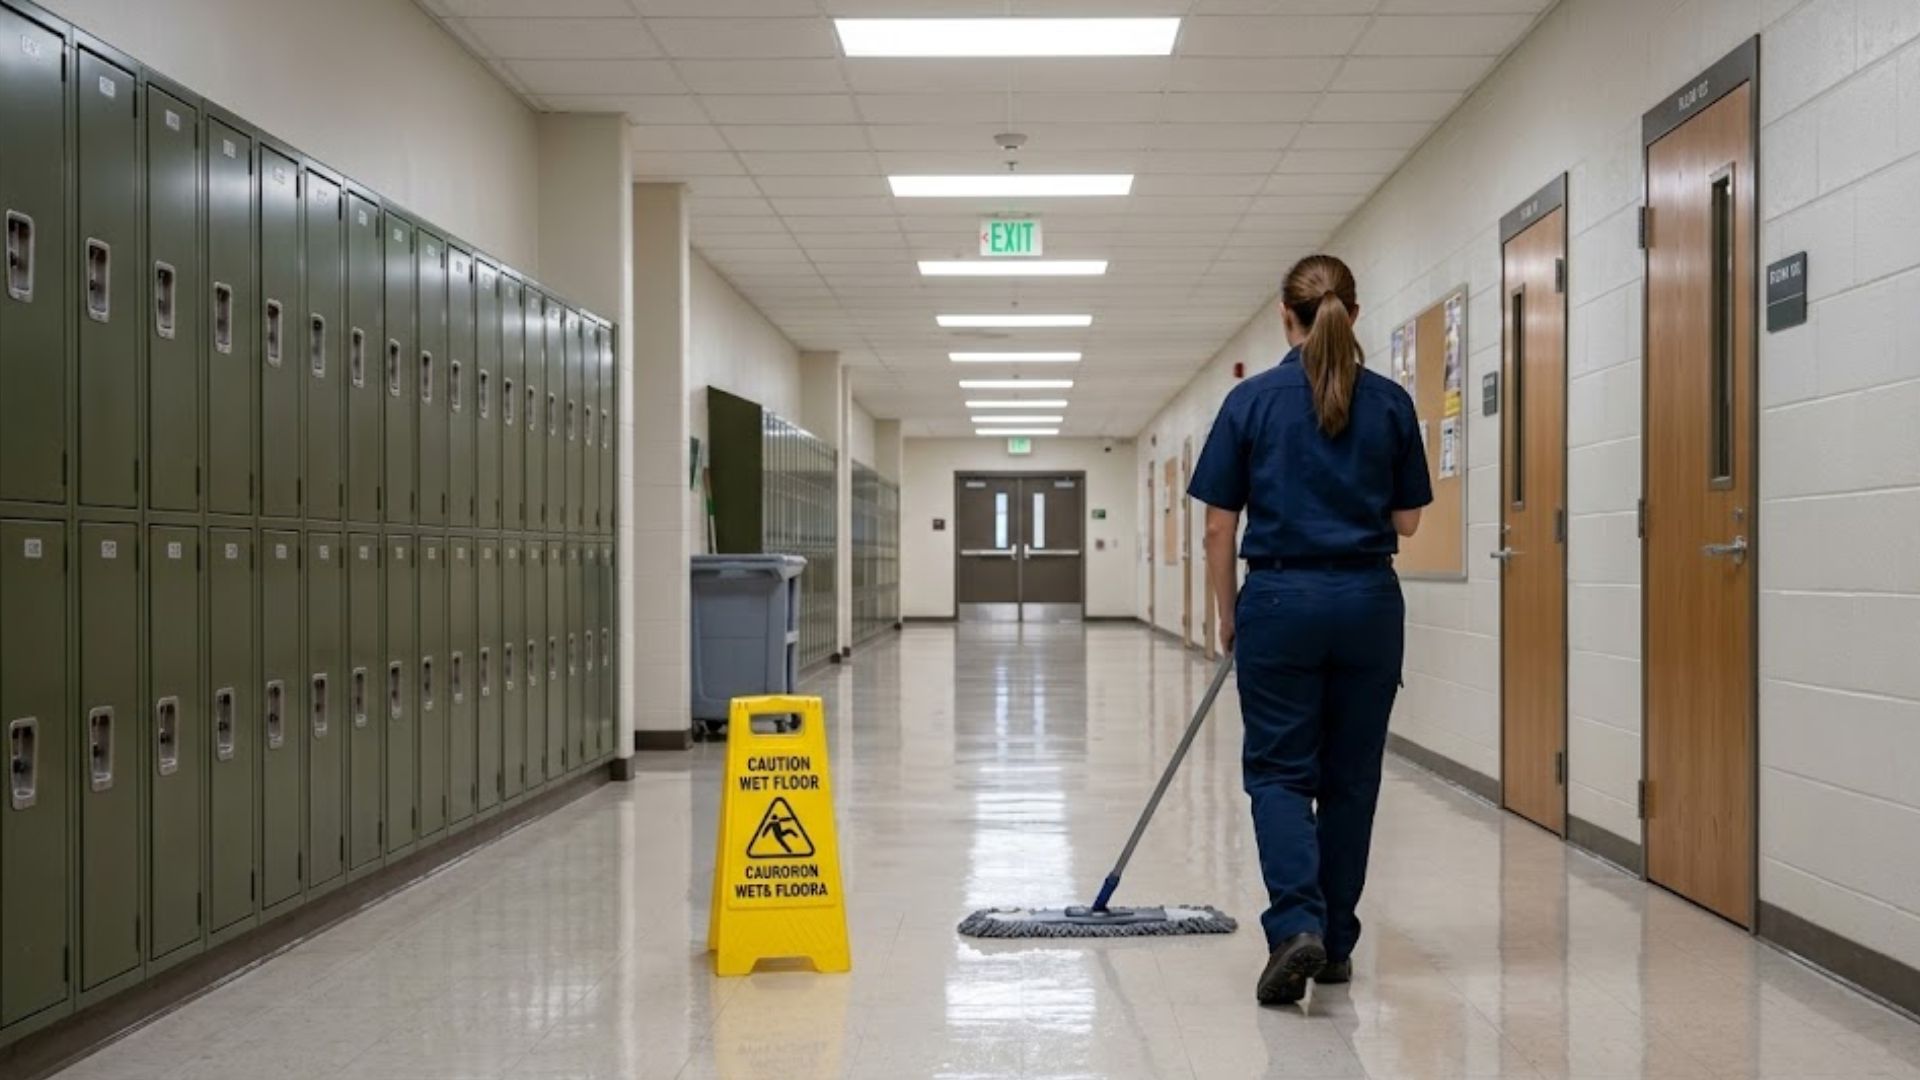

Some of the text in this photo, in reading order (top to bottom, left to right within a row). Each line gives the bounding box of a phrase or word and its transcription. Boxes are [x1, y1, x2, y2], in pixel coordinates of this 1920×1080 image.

[991, 221, 1034, 252] EXIT
[748, 756, 811, 771] CAUTION
[740, 775, 819, 790] WET FLOOR
[775, 882, 828, 897] FLOORA
